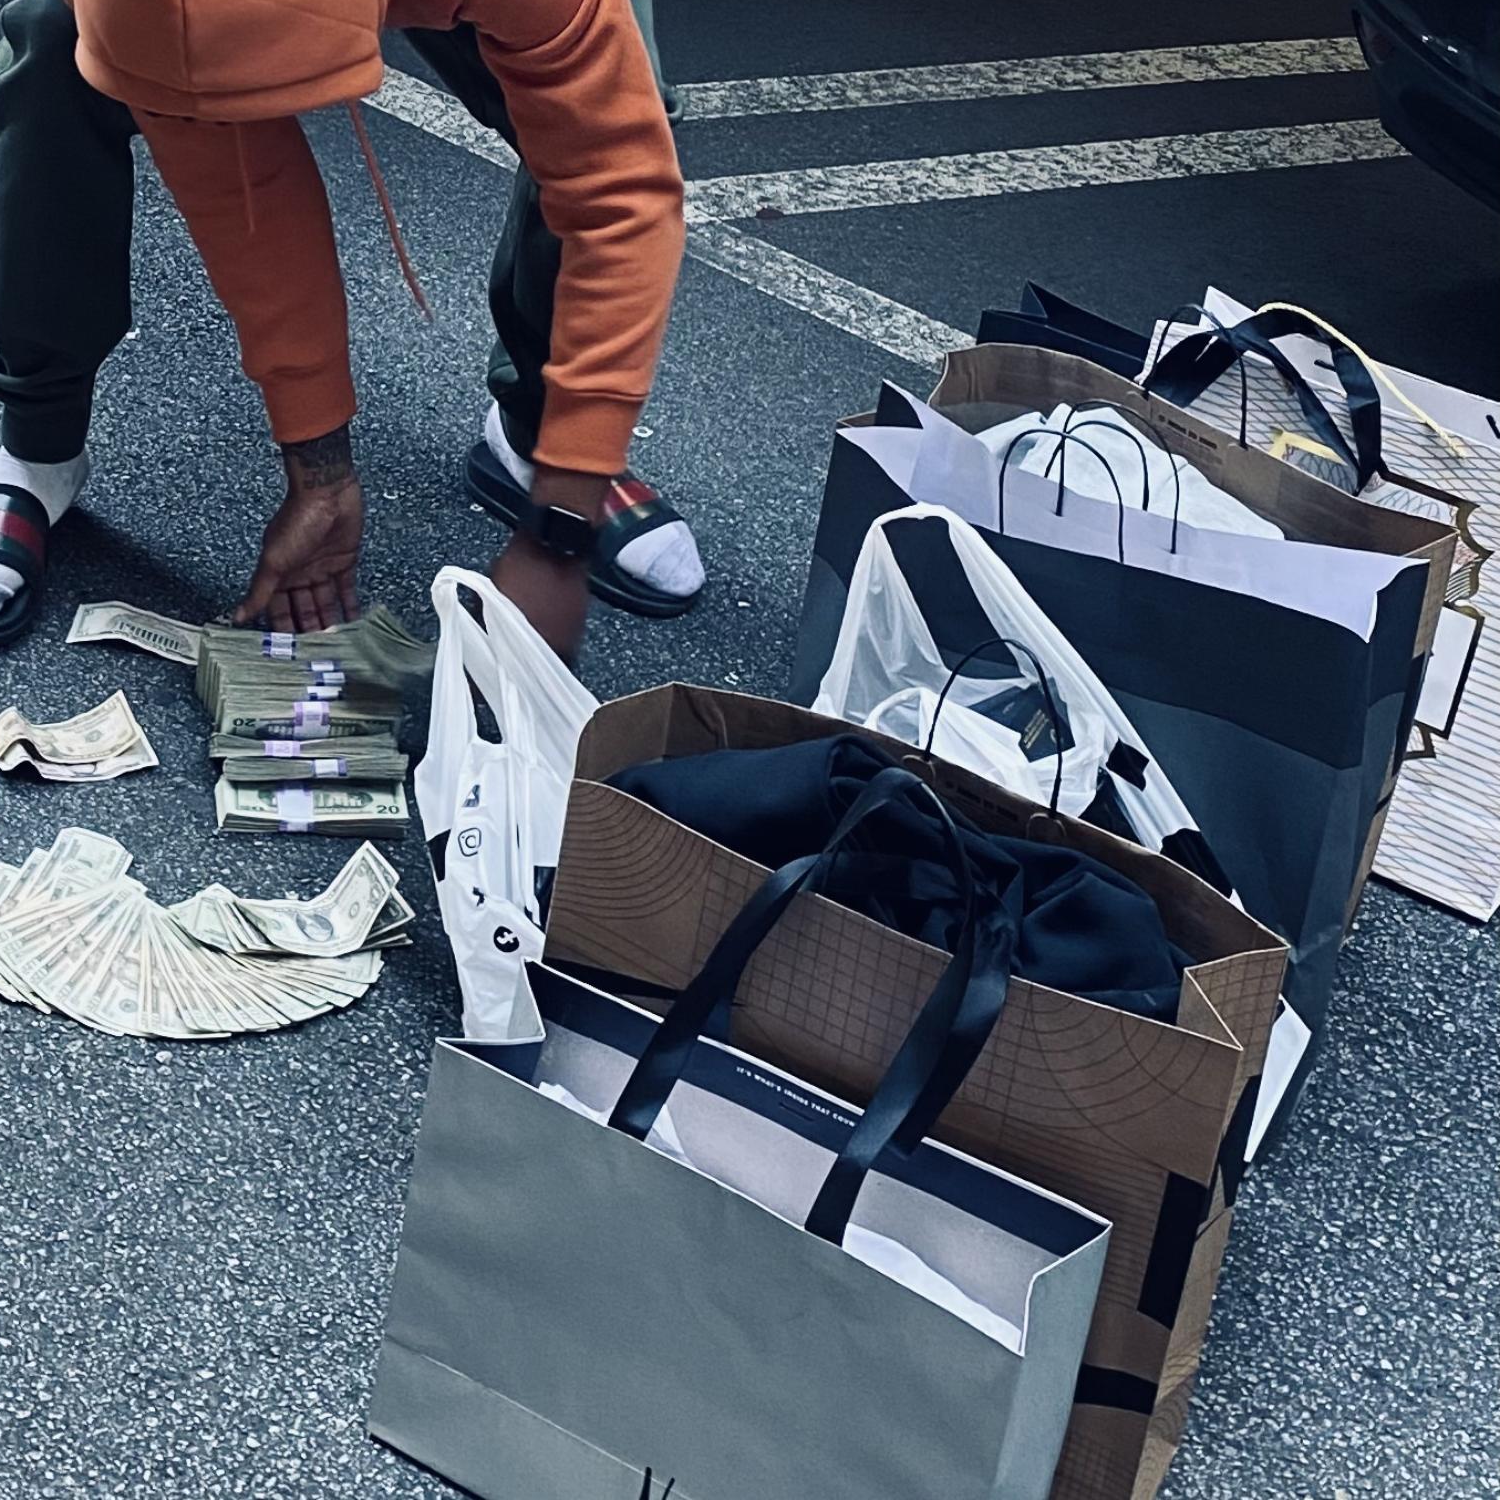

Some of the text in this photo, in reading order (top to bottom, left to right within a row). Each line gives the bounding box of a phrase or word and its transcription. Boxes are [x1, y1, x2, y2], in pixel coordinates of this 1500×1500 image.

[233, 717, 257, 728] 20
[376, 805, 400, 815] 20
[811, 1102, 831, 1116] THAT
[832, 1113, 855, 1127] COUN
